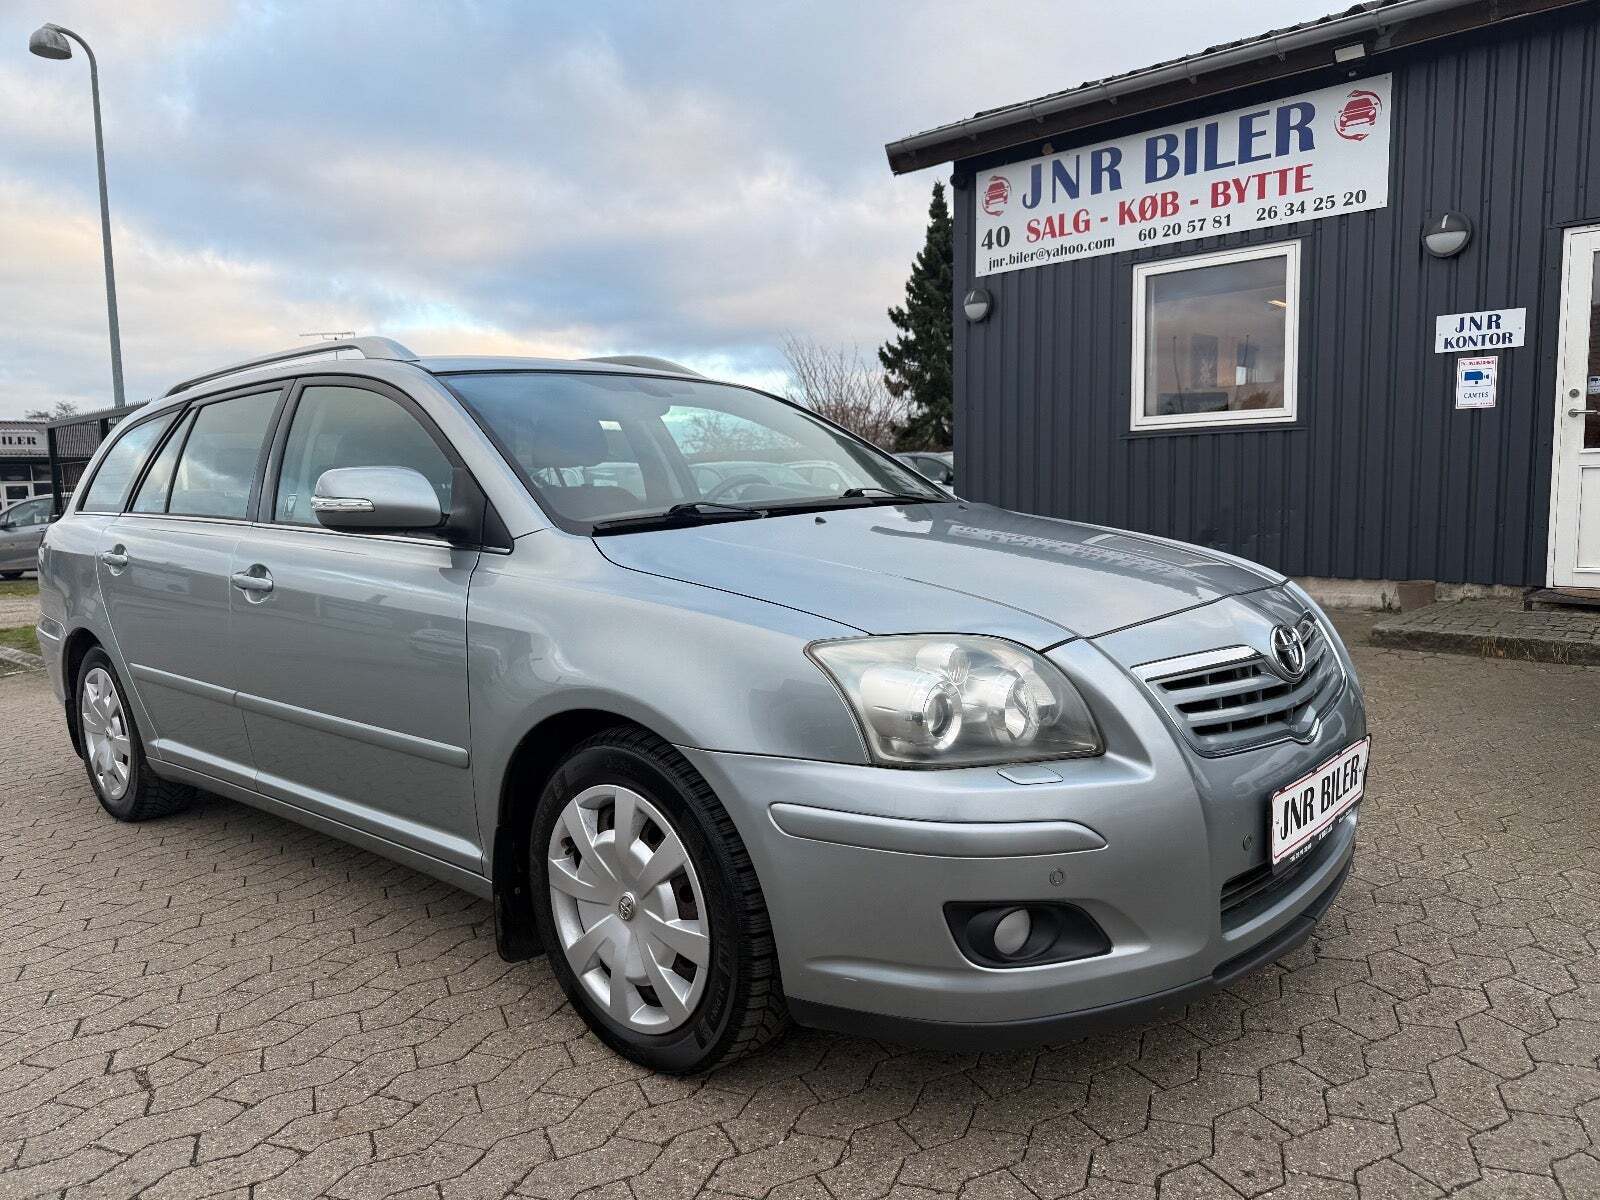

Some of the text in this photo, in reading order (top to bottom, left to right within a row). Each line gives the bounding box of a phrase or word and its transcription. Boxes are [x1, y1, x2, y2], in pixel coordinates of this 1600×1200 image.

[1022, 101, 1316, 209] JNR BILER
[1026, 208, 1091, 243] SALG
[1118, 190, 1180, 226] KØB
[1210, 163, 1314, 209] BYTTE
[1256, 189, 1367, 221] 26 34 25 20
[981, 225, 1011, 250] 40
[1138, 213, 1231, 241] 60 20 57 81
[987, 237, 1116, 271] jnr.biler@yahoo.com
[1455, 313, 1502, 333] JNR
[1443, 331, 1514, 350] KONTOR
[1280, 754, 1360, 840] JNR BILER
